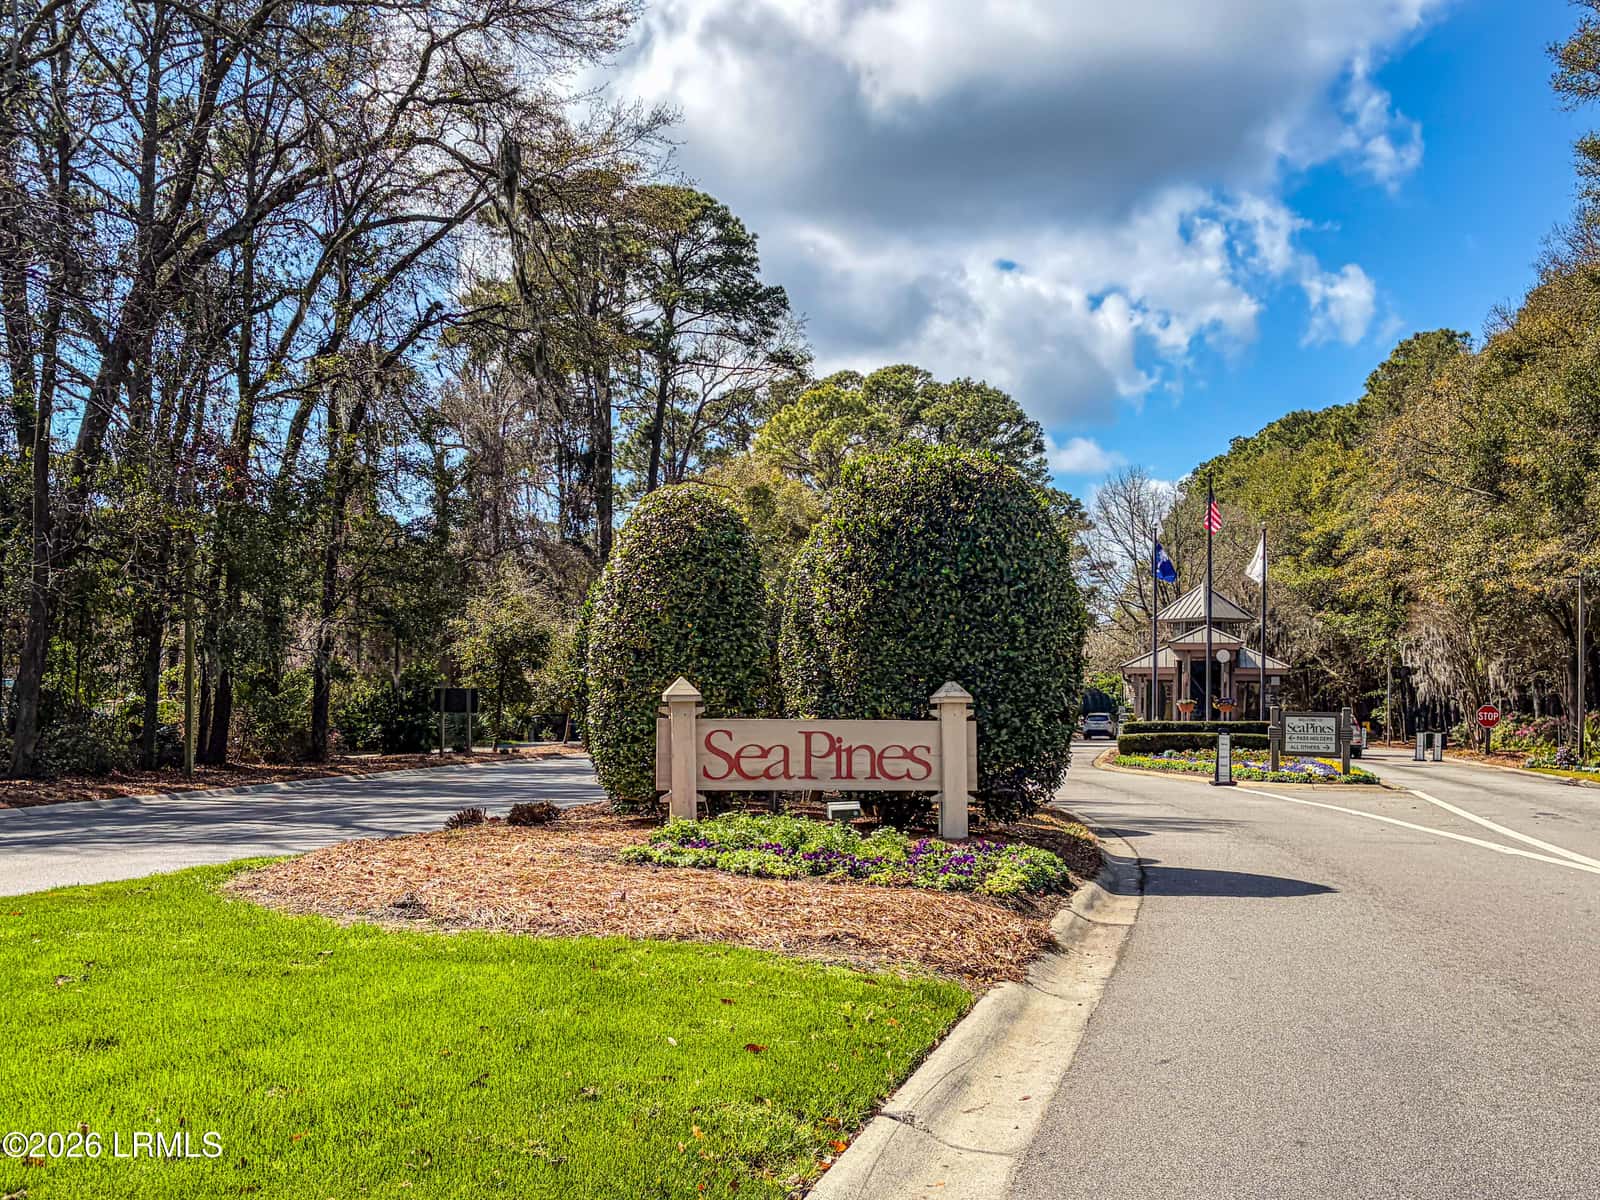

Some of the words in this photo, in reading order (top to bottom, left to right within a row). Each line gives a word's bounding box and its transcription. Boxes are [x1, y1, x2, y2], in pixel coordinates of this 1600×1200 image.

[1478, 712, 1499, 721] STOP
[1287, 722, 1305, 733] Sea
[1306, 723, 1334, 733] Pines
[702, 729, 795, 781] Sea
[797, 730, 932, 781] Pines
